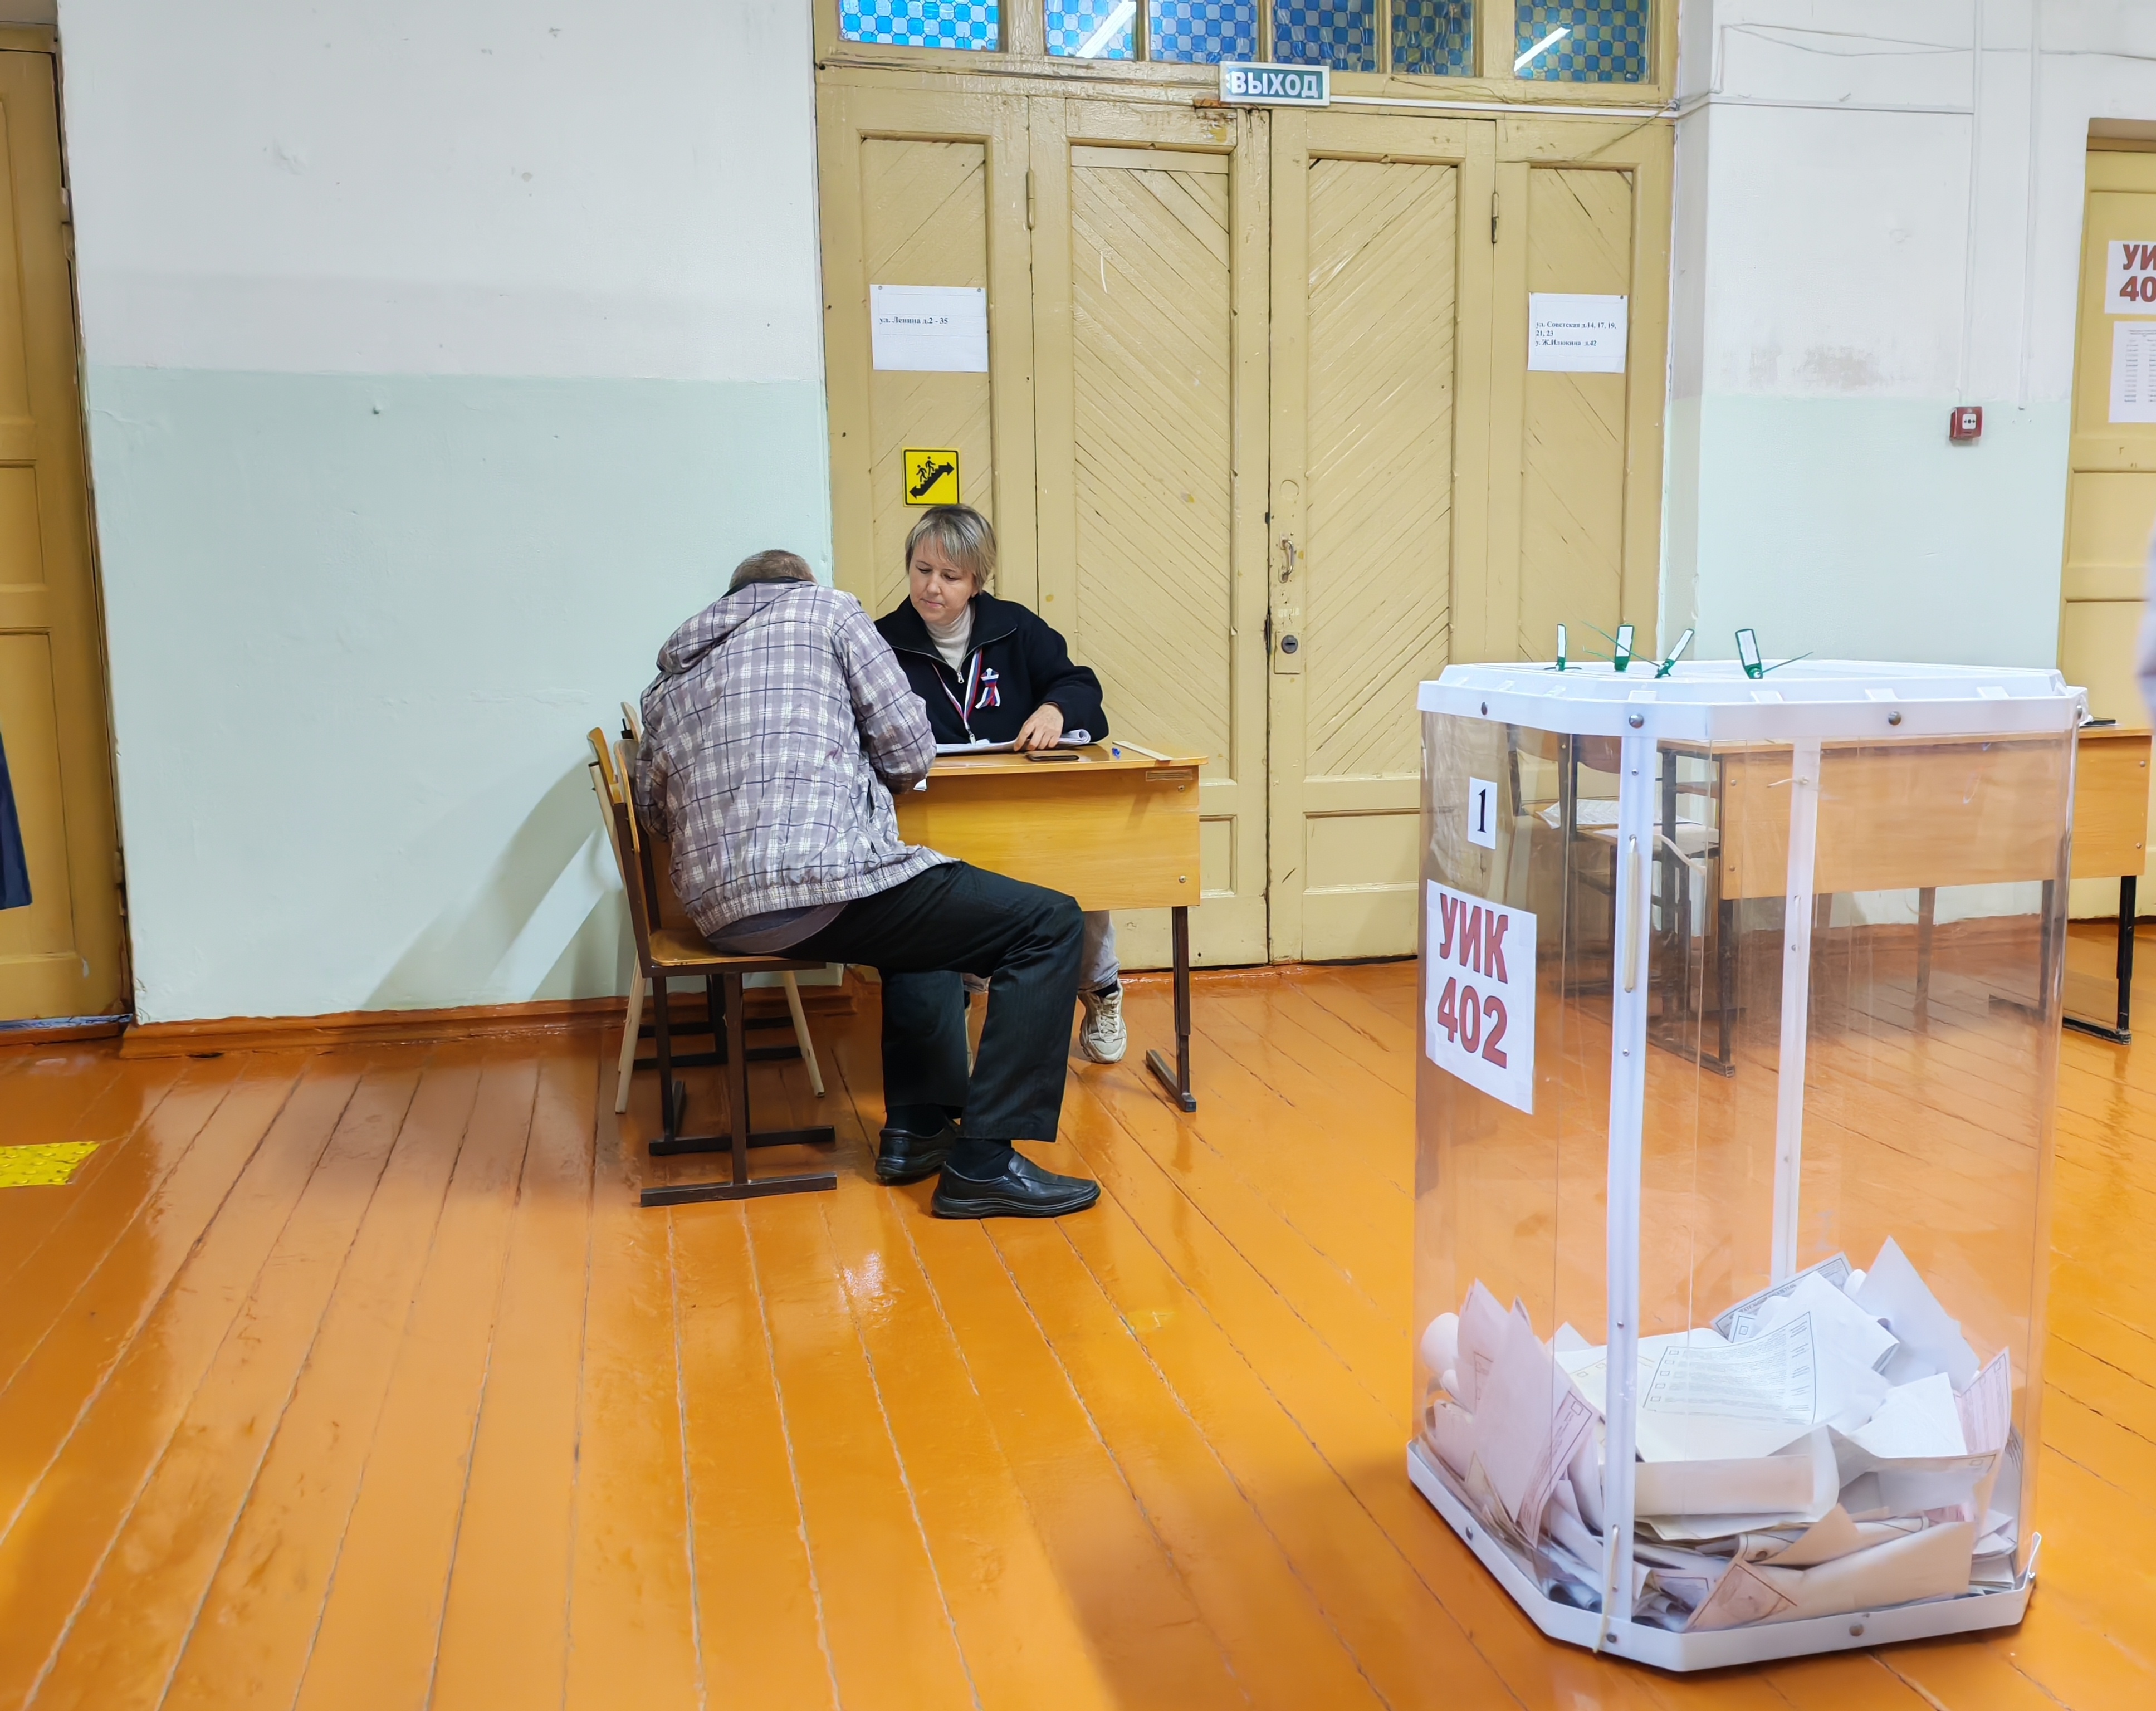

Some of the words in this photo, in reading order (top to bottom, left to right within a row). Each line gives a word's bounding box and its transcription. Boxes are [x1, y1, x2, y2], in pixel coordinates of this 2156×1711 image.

[1231, 71, 1319, 99] ВЫХОД
[1477, 788, 1487, 834] 1
[1439, 892, 1509, 985] УИК
[1436, 976, 1508, 1070] 402
